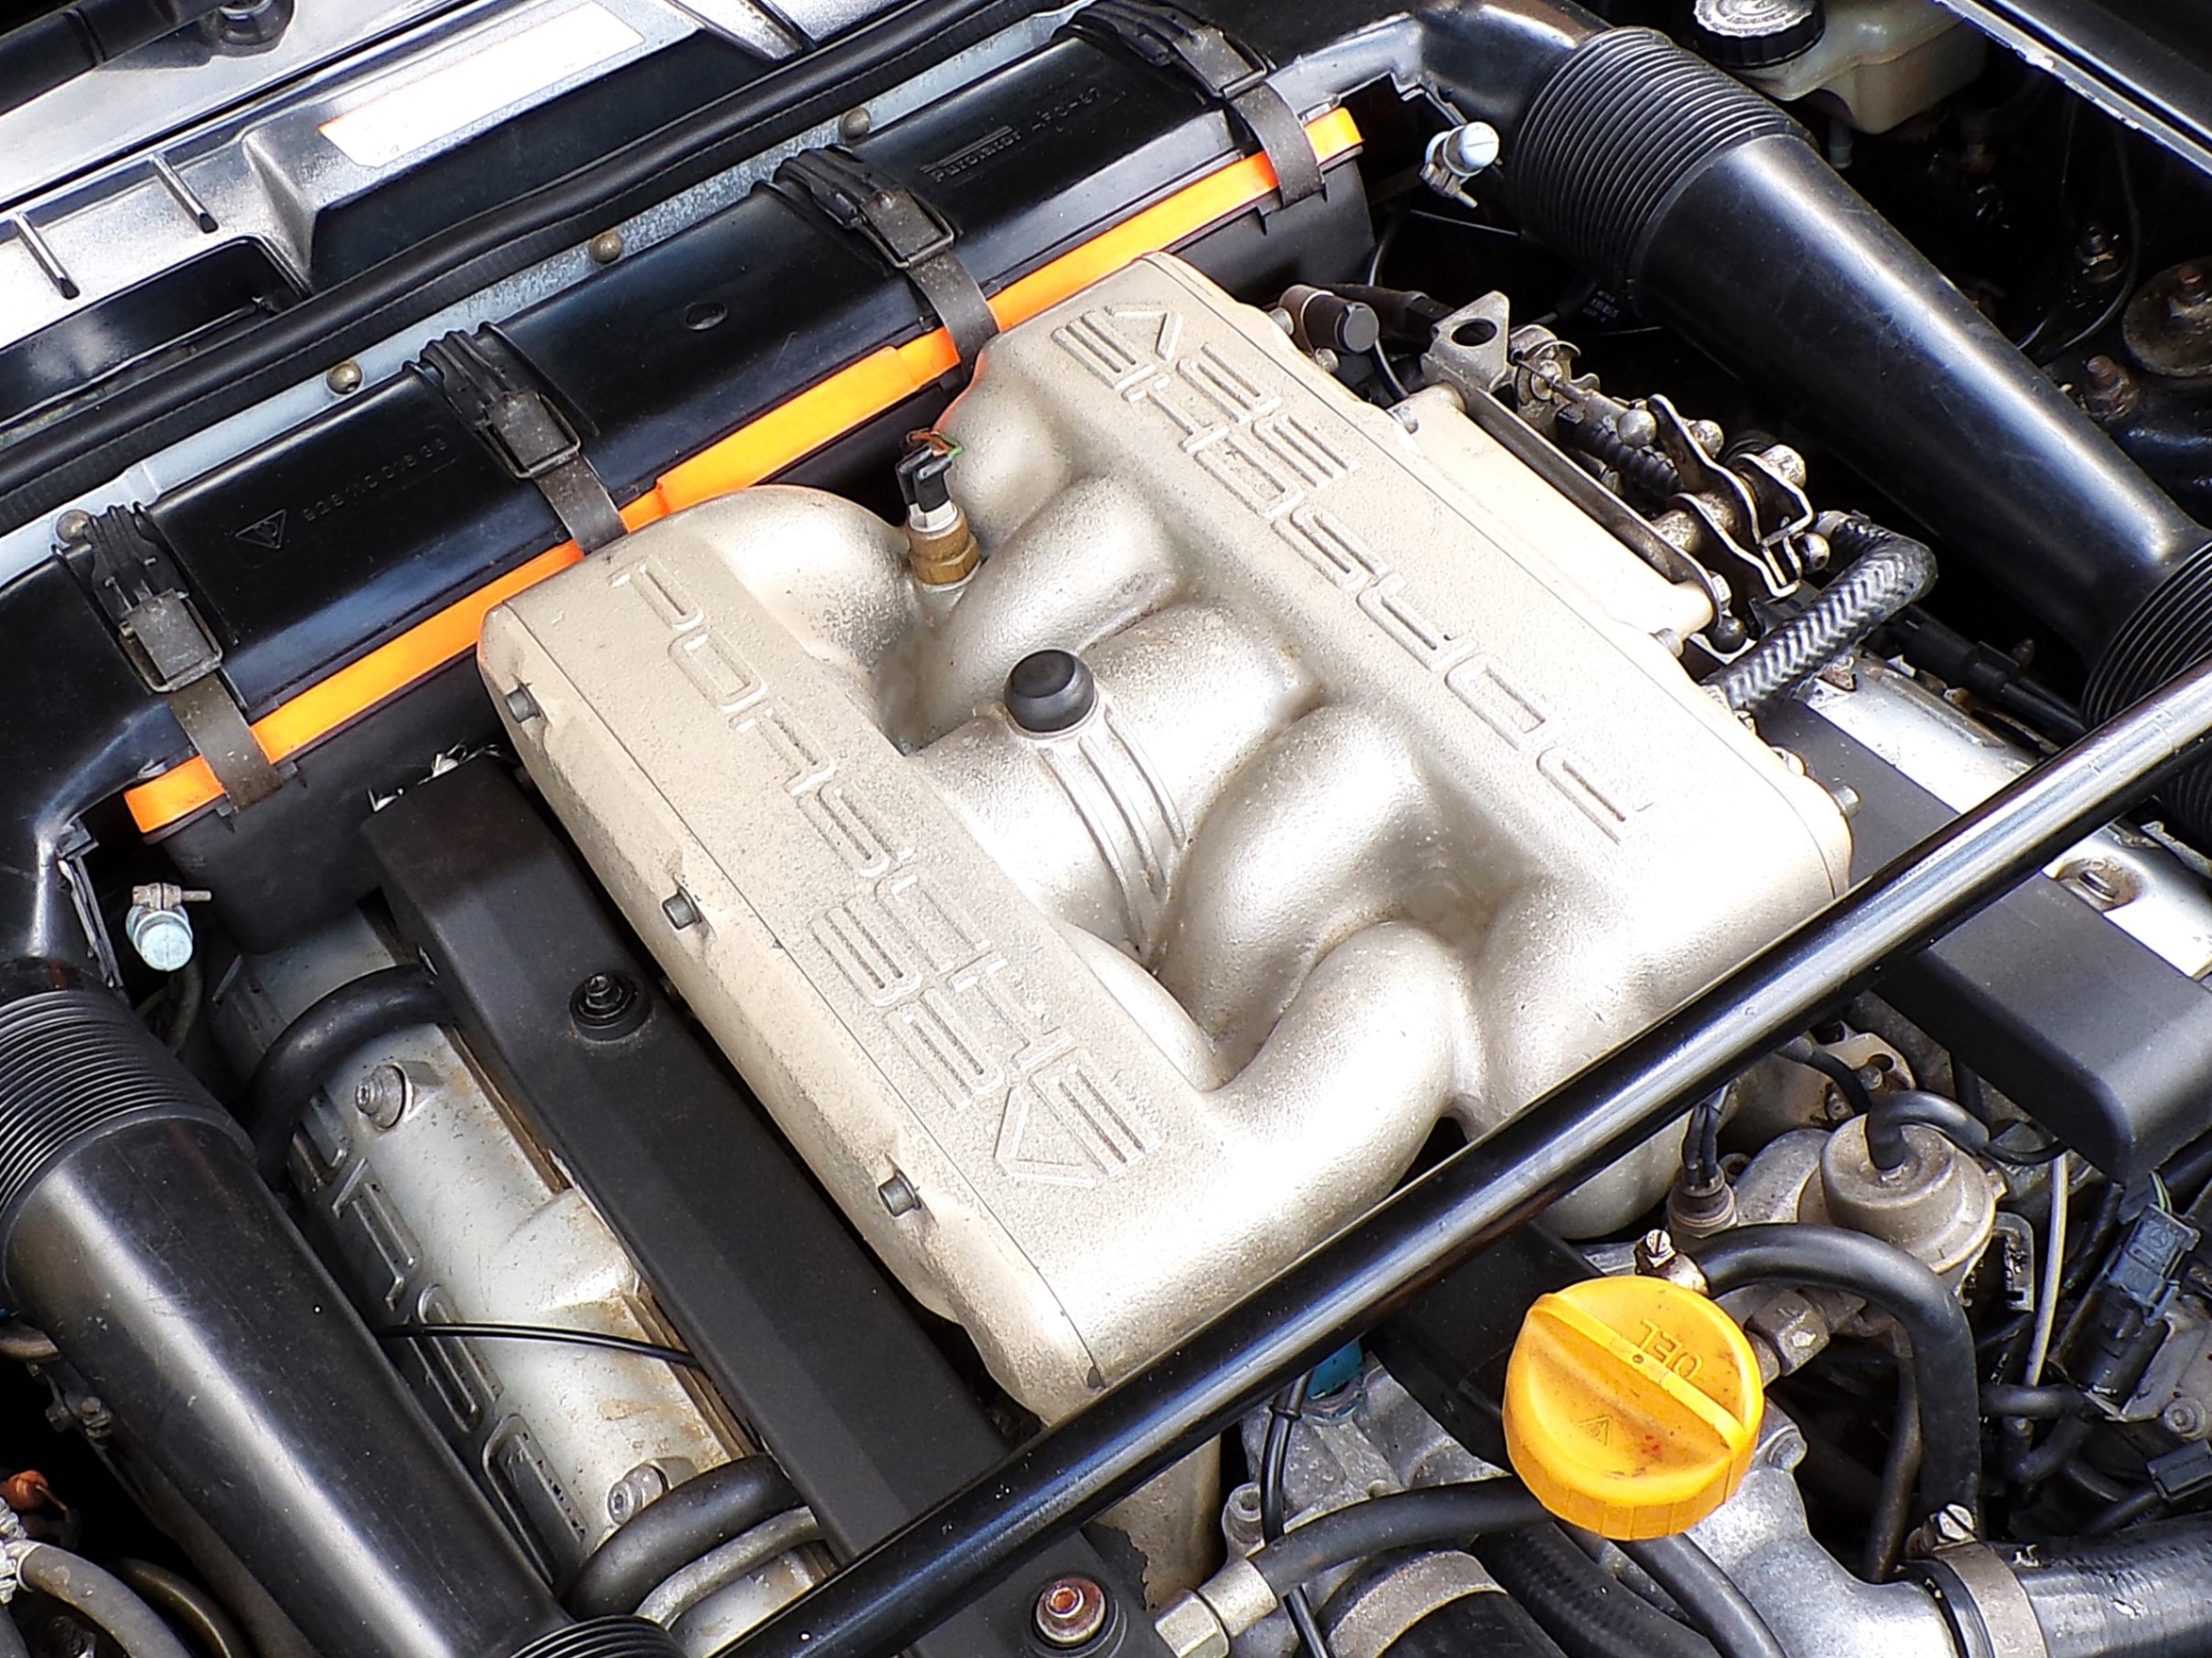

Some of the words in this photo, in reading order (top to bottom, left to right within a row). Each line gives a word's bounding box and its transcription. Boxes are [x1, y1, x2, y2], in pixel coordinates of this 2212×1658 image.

[930, 130, 1021, 183] Purolator
[1105, 307, 1359, 487] 32V
[1050, 314, 1651, 844] PORSCHE
[610, 559, 1160, 1179] PORSCHE
[809, 897, 1093, 1179] 32V
[1640, 1318, 1703, 1381] OEL
